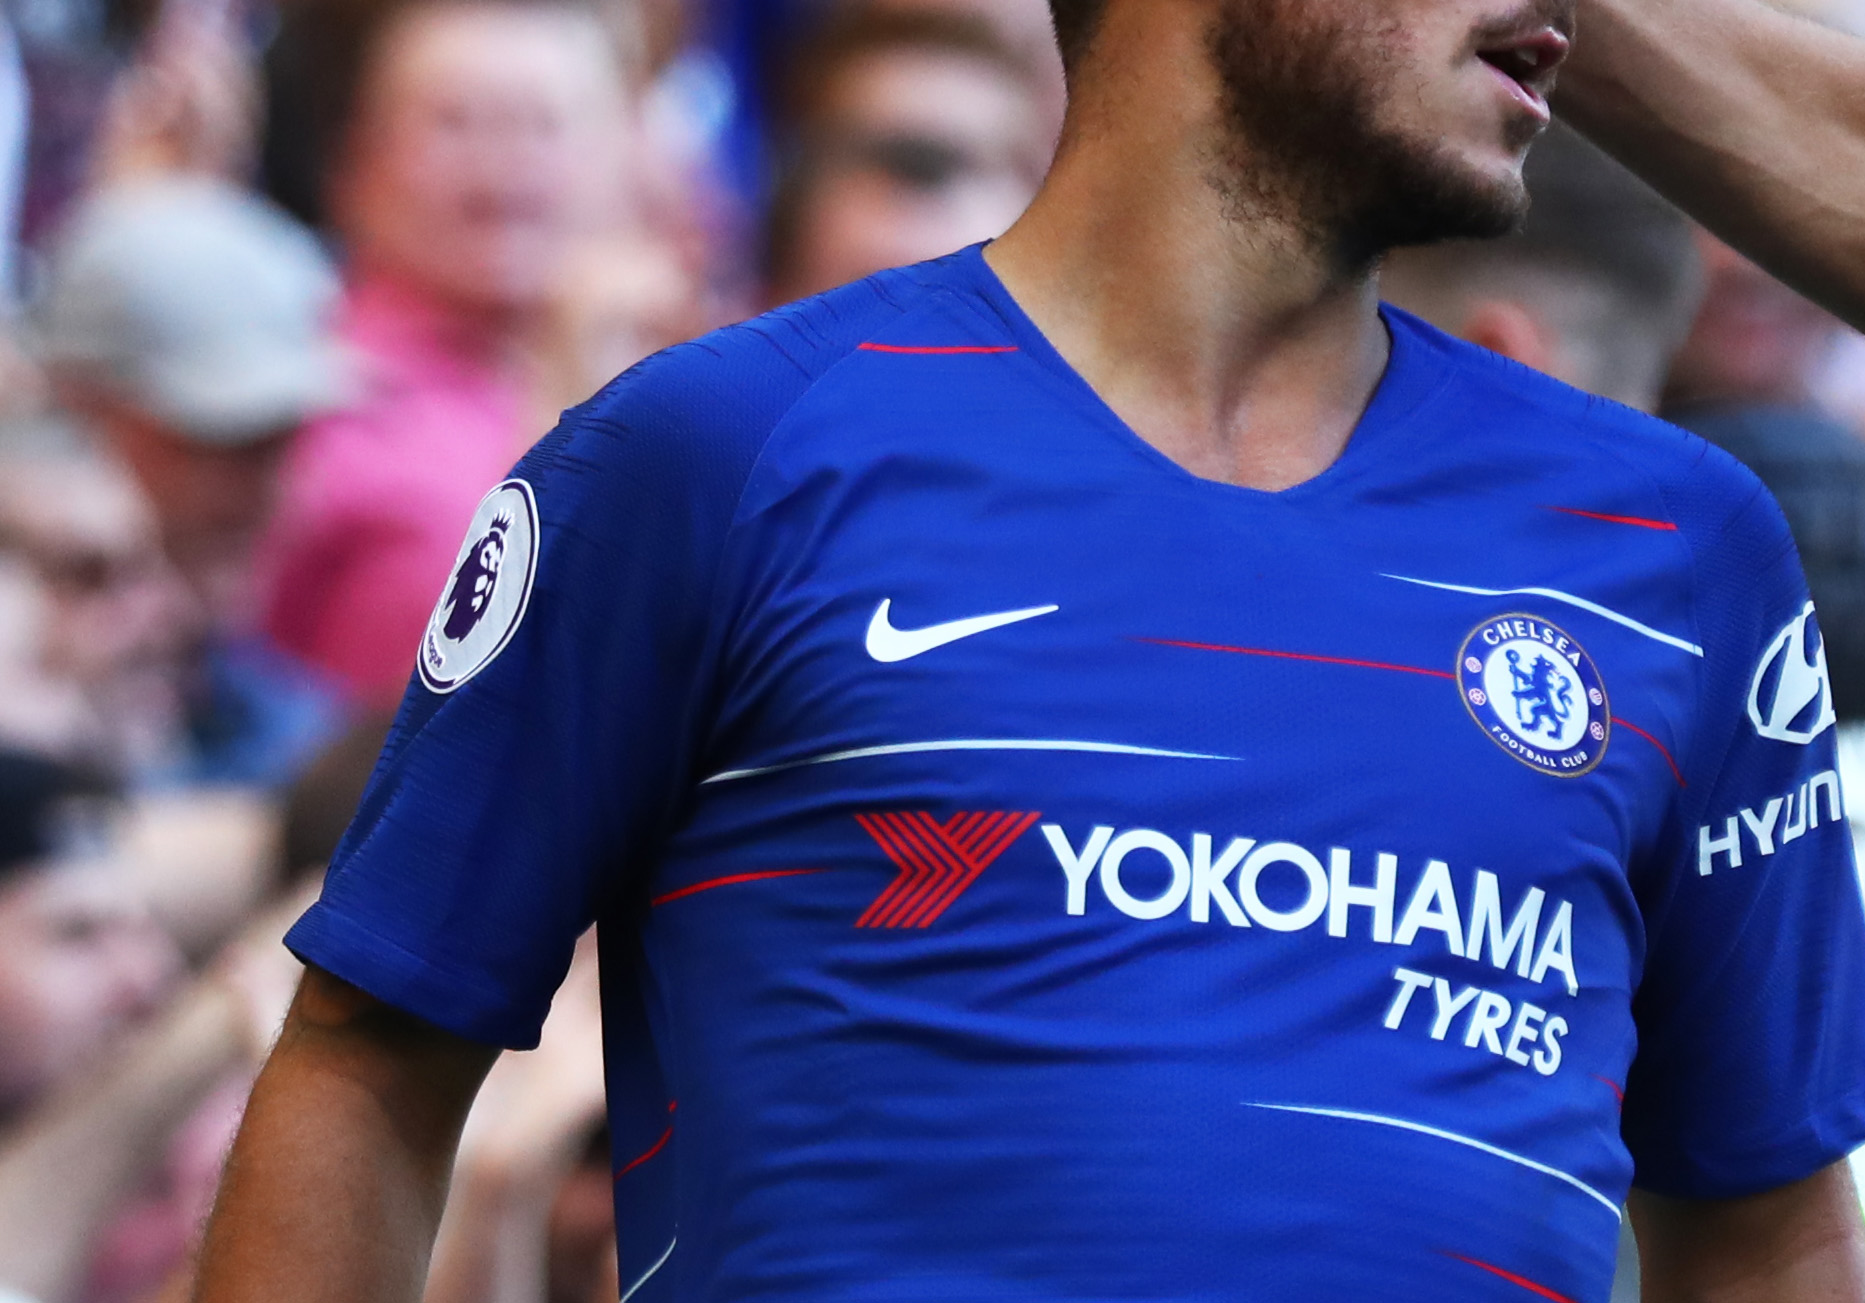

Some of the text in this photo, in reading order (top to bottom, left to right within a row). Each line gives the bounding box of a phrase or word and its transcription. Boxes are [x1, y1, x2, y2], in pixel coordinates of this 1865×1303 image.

[1482, 620, 1581, 667] CHELSEA
[1492, 725, 1589, 768] FOOTBALL CLUB
[1040, 823, 1579, 998] YOKOHAMA
[1383, 966, 1569, 1077] TYRES
